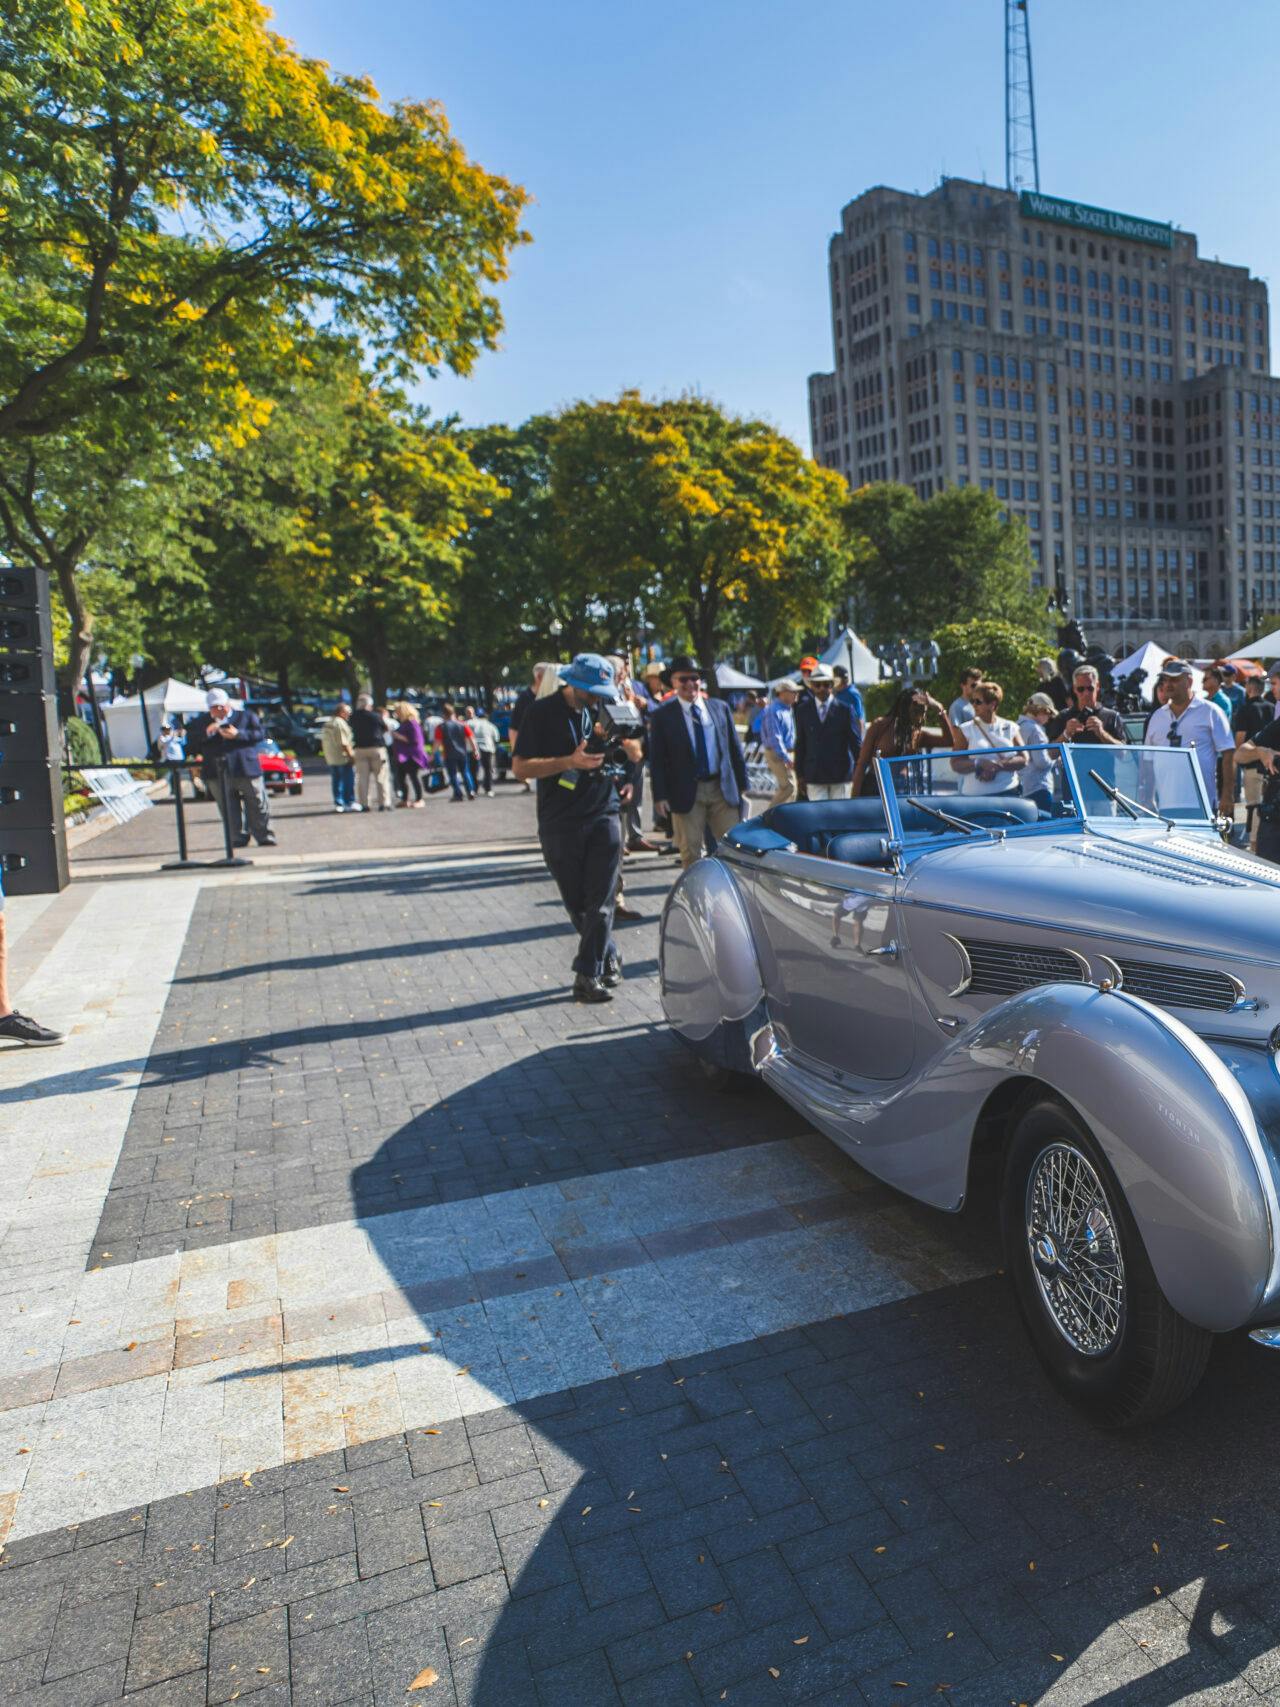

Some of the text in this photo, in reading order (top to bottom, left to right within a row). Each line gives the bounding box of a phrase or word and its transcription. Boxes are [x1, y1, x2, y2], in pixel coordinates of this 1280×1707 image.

[1028, 195, 1169, 242] WAYNE STATE UNIVERSITY
